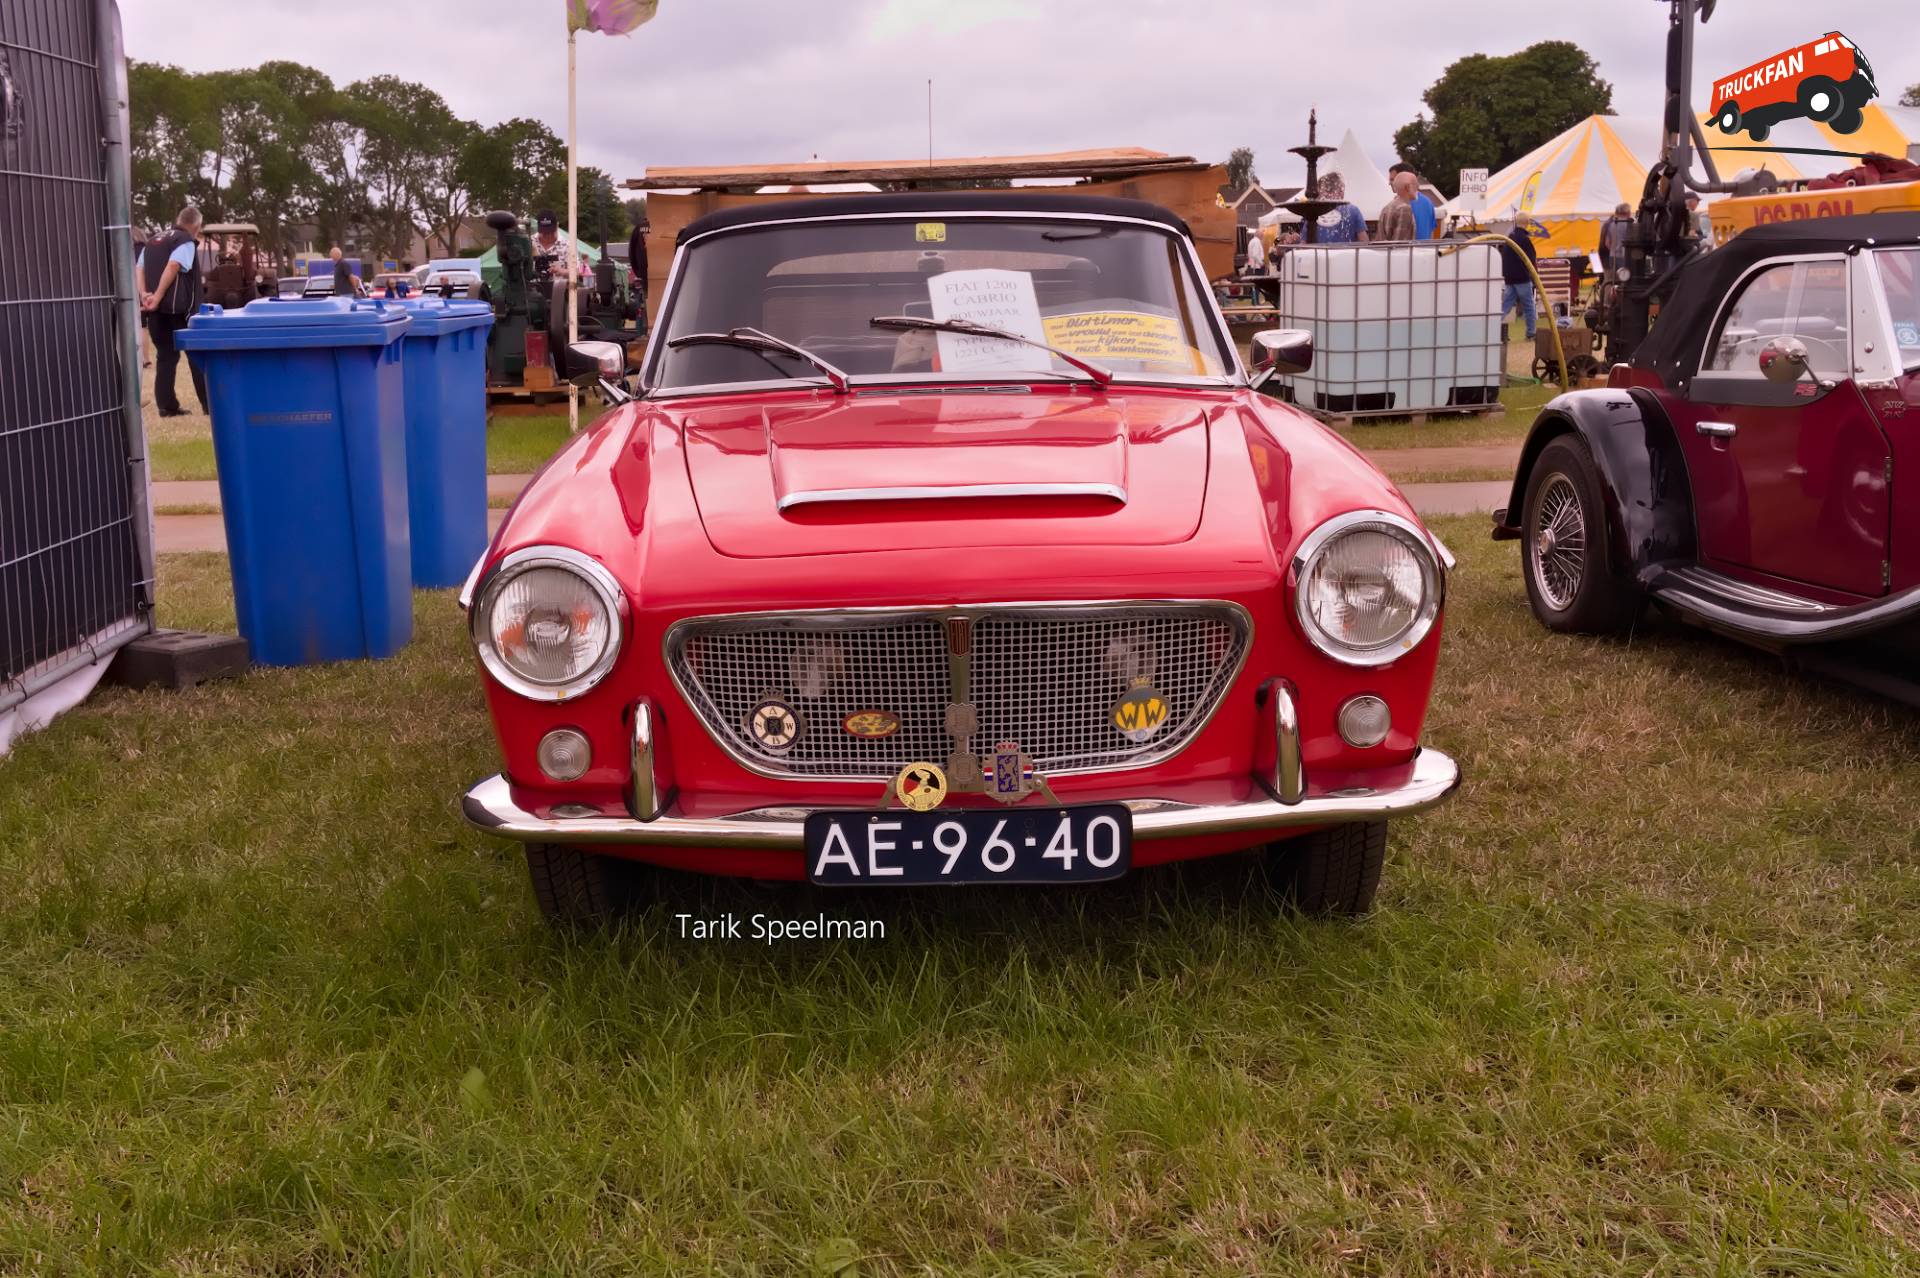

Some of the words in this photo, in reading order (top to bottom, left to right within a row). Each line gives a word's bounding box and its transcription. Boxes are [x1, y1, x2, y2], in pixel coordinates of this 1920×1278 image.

[1461, 184, 1488, 193] EHBO
[945, 282, 977, 294] FIAT
[985, 280, 1017, 291] 1200
[953, 293, 1017, 306] CABRIO
[814, 815, 1120, 877] AE-96-40
